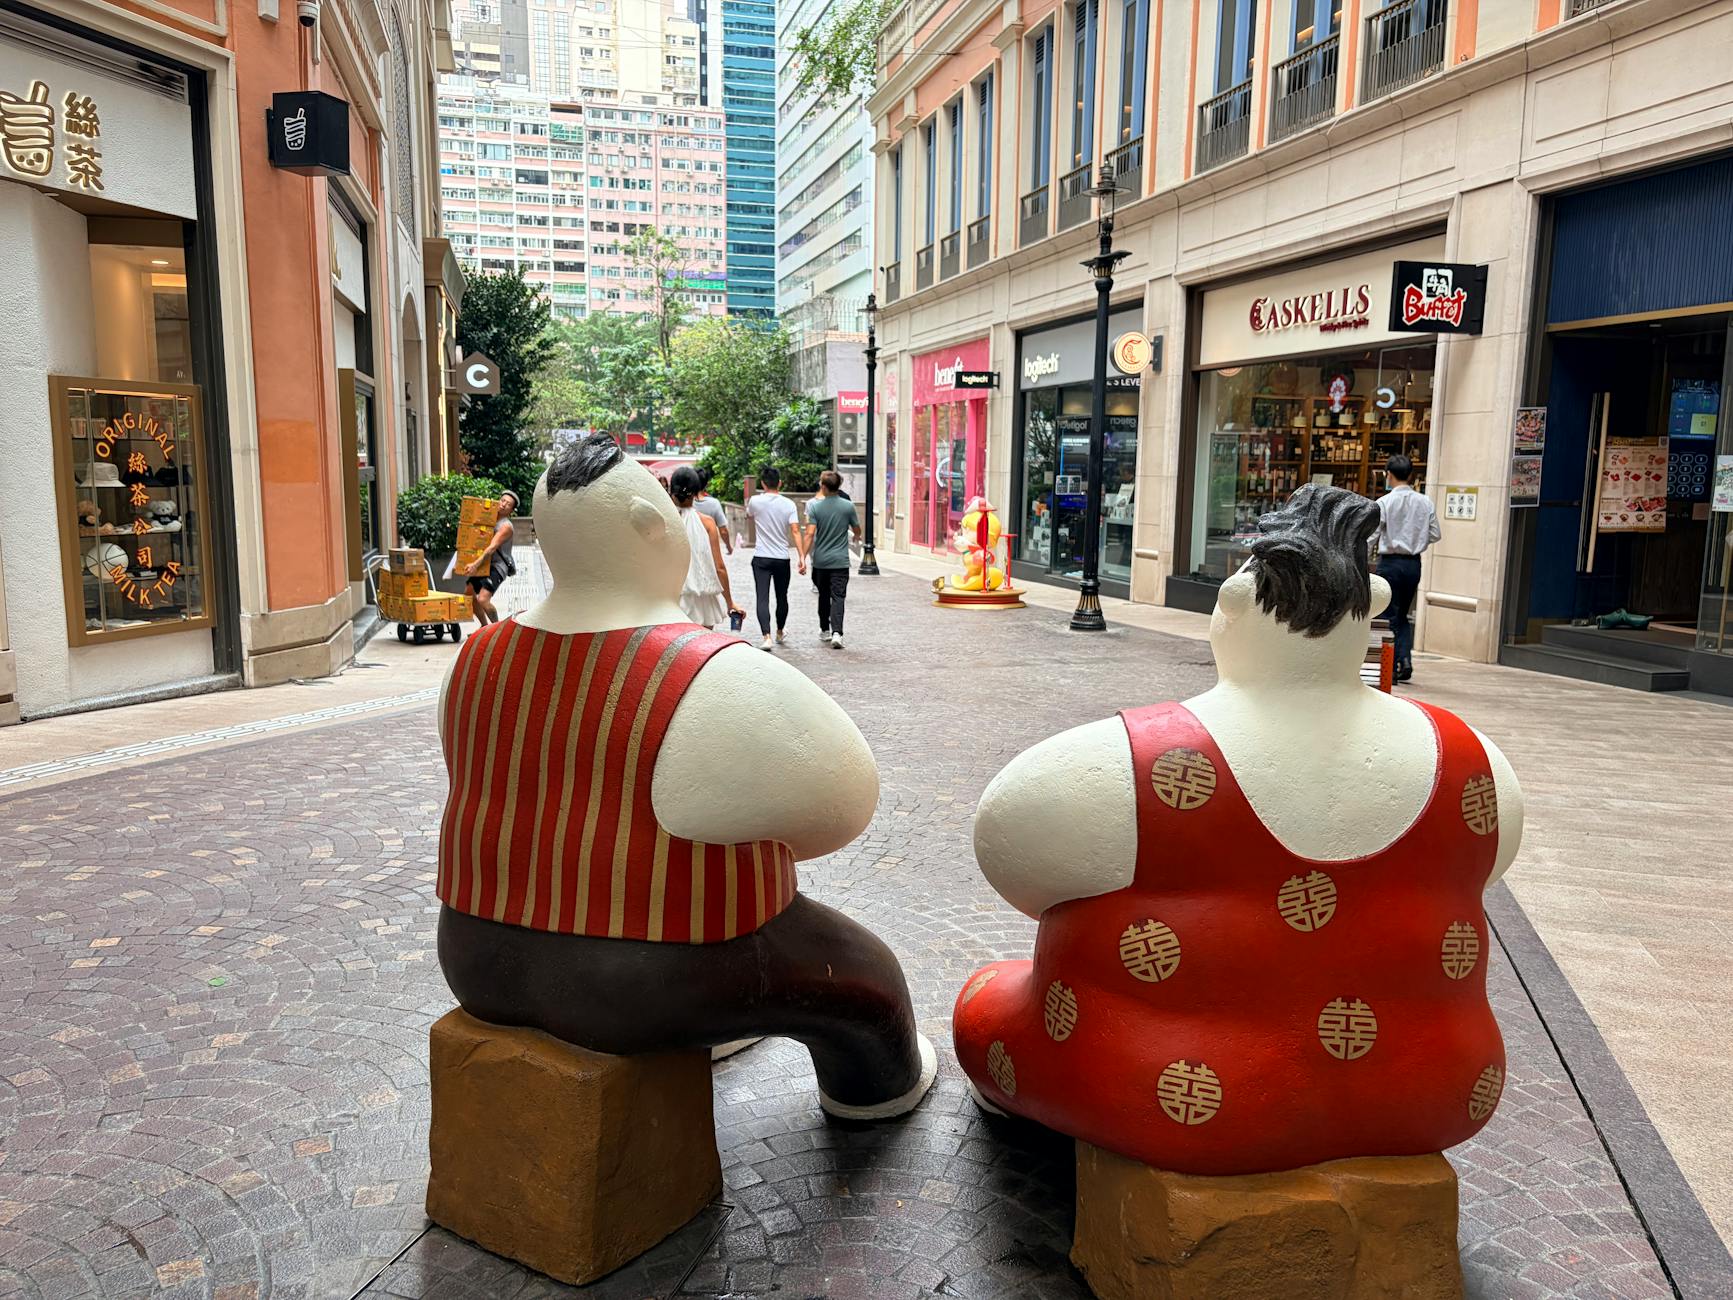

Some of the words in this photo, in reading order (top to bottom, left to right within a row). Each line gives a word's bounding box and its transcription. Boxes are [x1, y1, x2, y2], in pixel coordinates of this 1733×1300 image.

[65, 92, 104, 190] 絲茶
[1250, 284, 1371, 331] CASKELLS
[1403, 284, 1467, 326] Buffet
[466, 364, 490, 388] C
[961, 374, 989, 386] logitech
[1024, 353, 1059, 383] logitech
[841, 396, 869, 409] benefi
[96, 412, 175, 459] ORIGINAL
[128, 452, 153, 568] 絲茶公司
[110, 564, 152, 605] MILK
[153, 559, 181, 596] TEA
